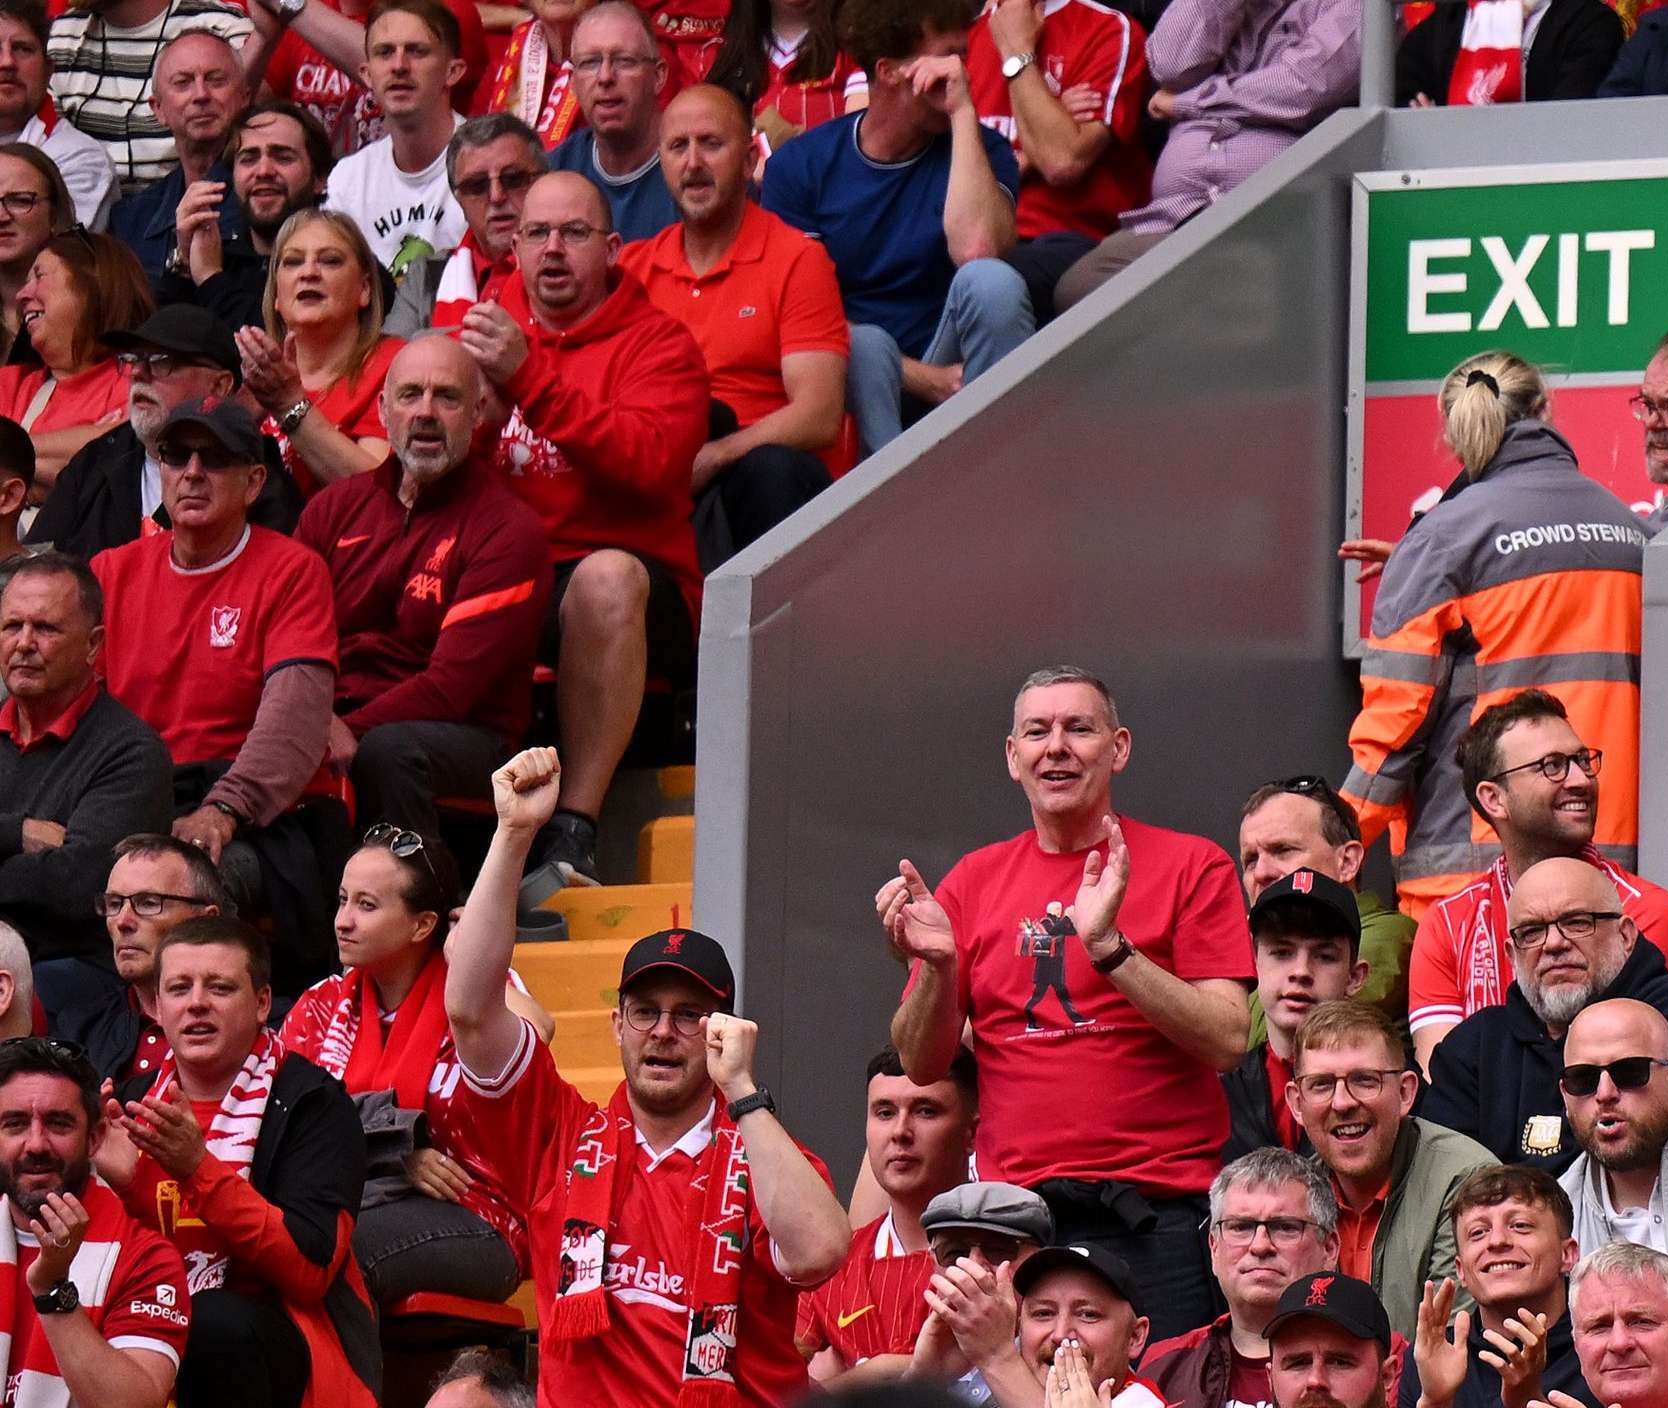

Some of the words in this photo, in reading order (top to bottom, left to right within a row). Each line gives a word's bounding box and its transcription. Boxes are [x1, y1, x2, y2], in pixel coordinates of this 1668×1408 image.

[1407, 229, 1656, 334] EXIT
[1495, 524, 1576, 556] CROWD
[1577, 523, 1646, 548] STEWAR
[130, 1300, 189, 1327] Expedia
